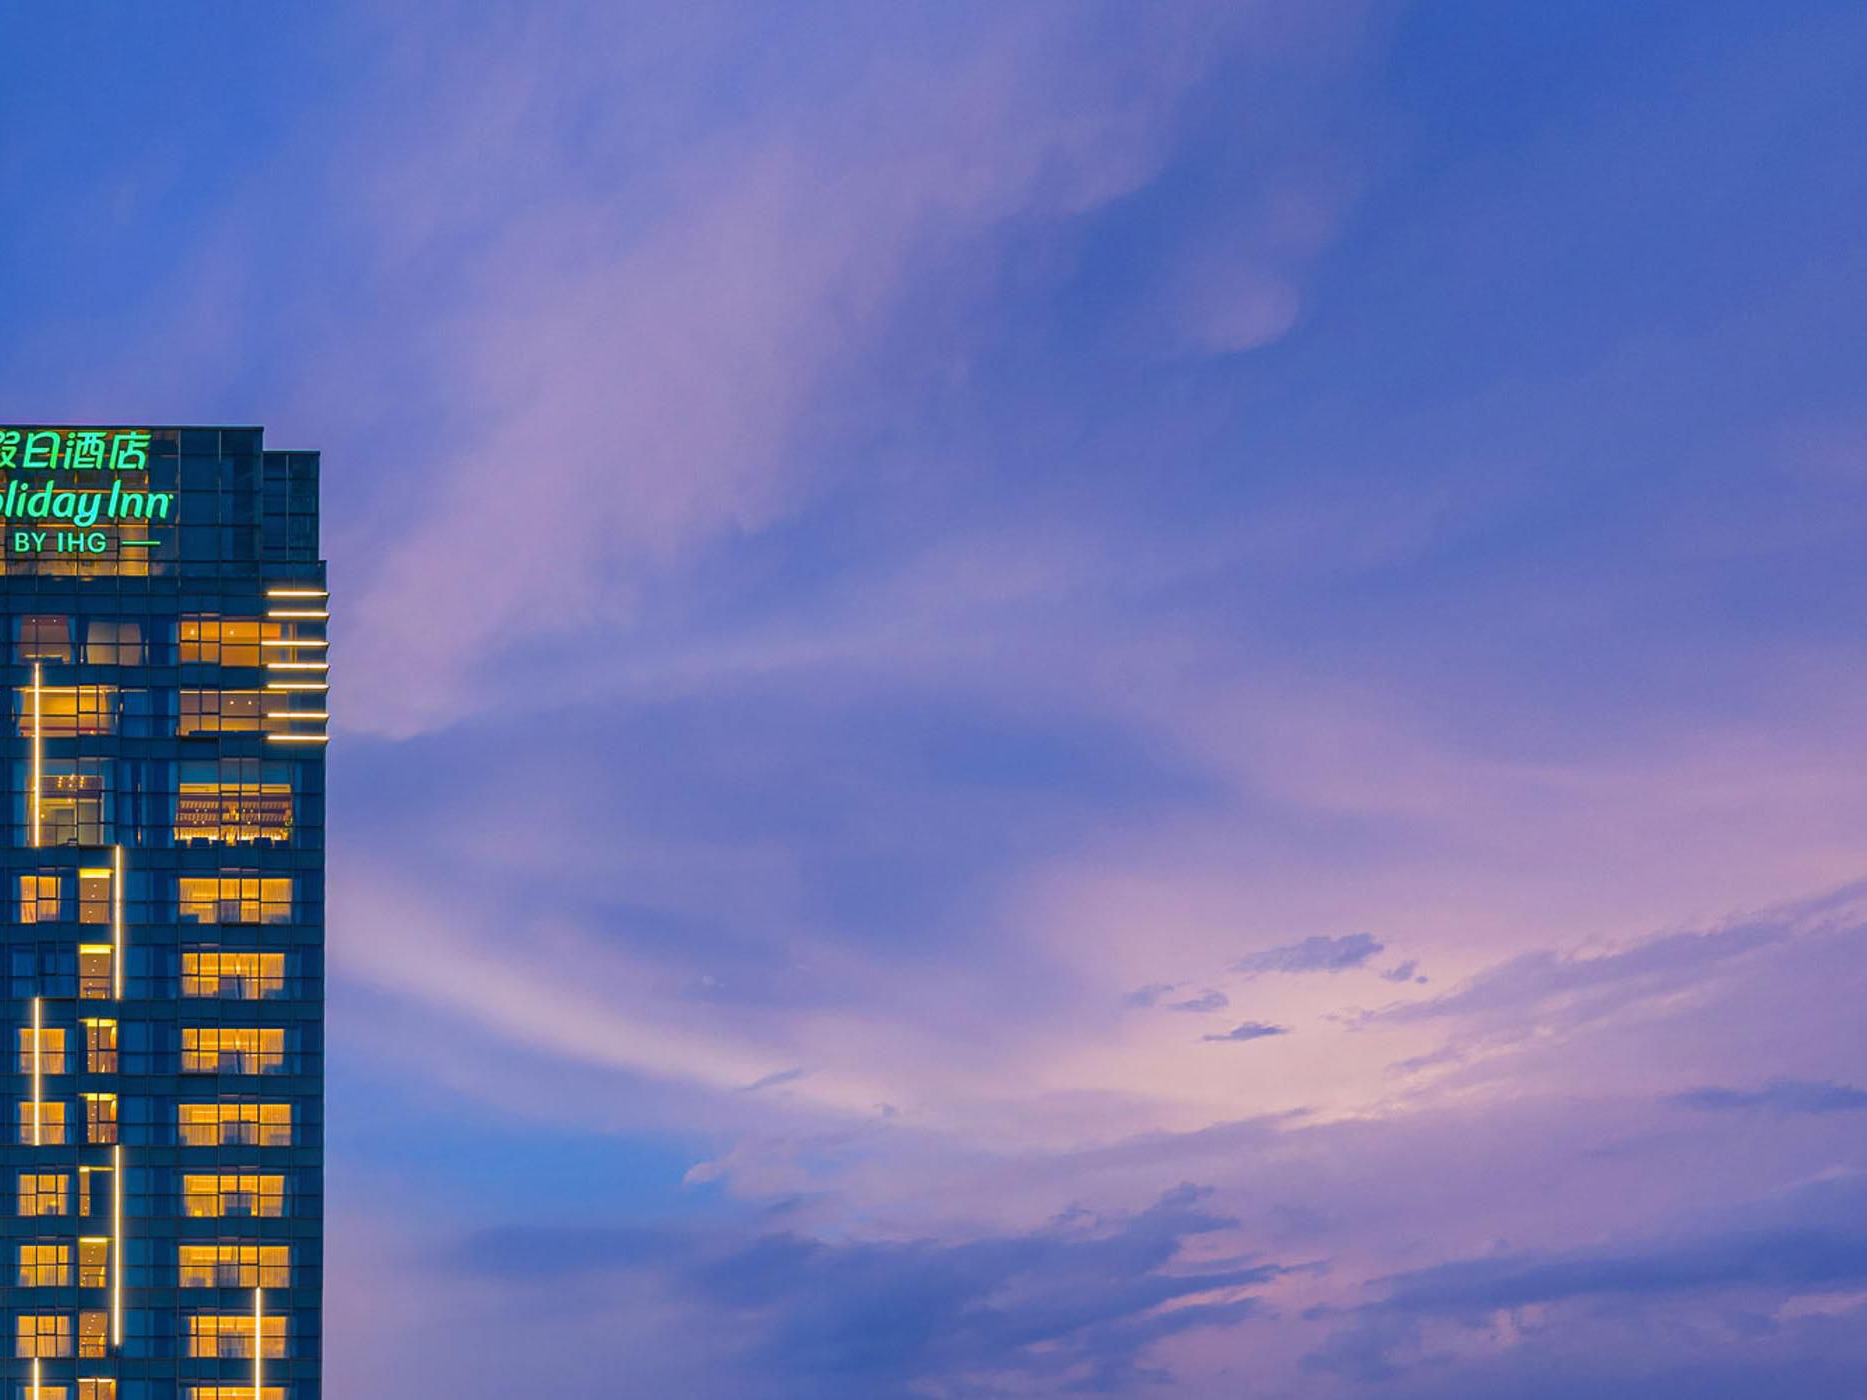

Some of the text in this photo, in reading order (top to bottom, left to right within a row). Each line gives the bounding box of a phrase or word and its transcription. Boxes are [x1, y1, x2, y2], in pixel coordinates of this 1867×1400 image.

[107, 479, 171, 519] Inn
[14, 532, 108, 553] BY IHG
